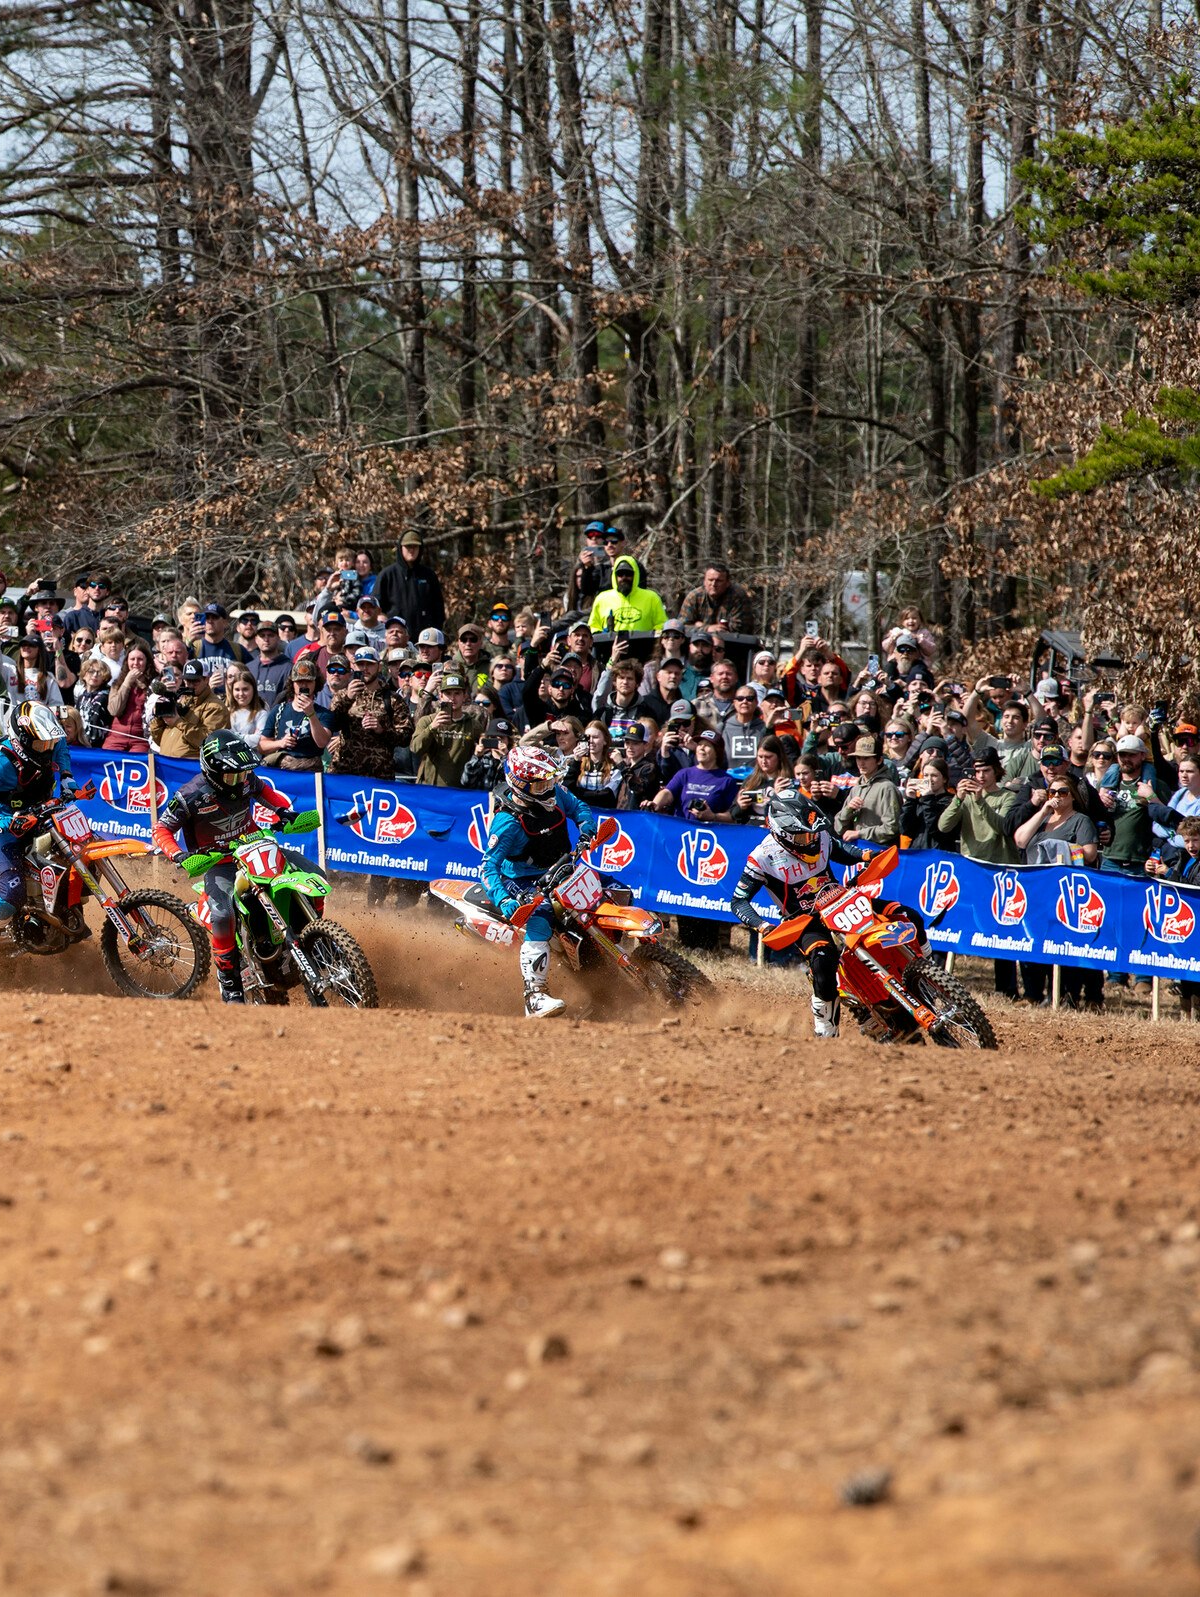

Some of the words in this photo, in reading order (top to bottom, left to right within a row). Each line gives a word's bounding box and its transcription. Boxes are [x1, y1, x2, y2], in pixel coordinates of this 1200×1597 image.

[104, 759, 150, 809] VP
[62, 811, 90, 840] 407
[353, 789, 399, 841] VP
[379, 820, 415, 836] Racing
[245, 842, 281, 875] 17
[326, 848, 428, 872] #MoreThanRaceFuel
[604, 846, 633, 864] Racing
[681, 829, 717, 884] VP
[565, 870, 602, 910] 514
[699, 876, 717, 884] FUELS
[926, 860, 954, 914] VP
[832, 895, 873, 932] 969
[1059, 873, 1091, 932] VP
[1145, 883, 1182, 940] VP
[105, 907, 129, 938] DUNLOP
[485, 922, 515, 947] 514
[1163, 933, 1185, 941] FUELS
[1165, 917, 1194, 934] Racing
[970, 932, 1035, 952] #MoreThanRaceFuel
[1043, 939, 1117, 961] #MoreThanRaceFuel
